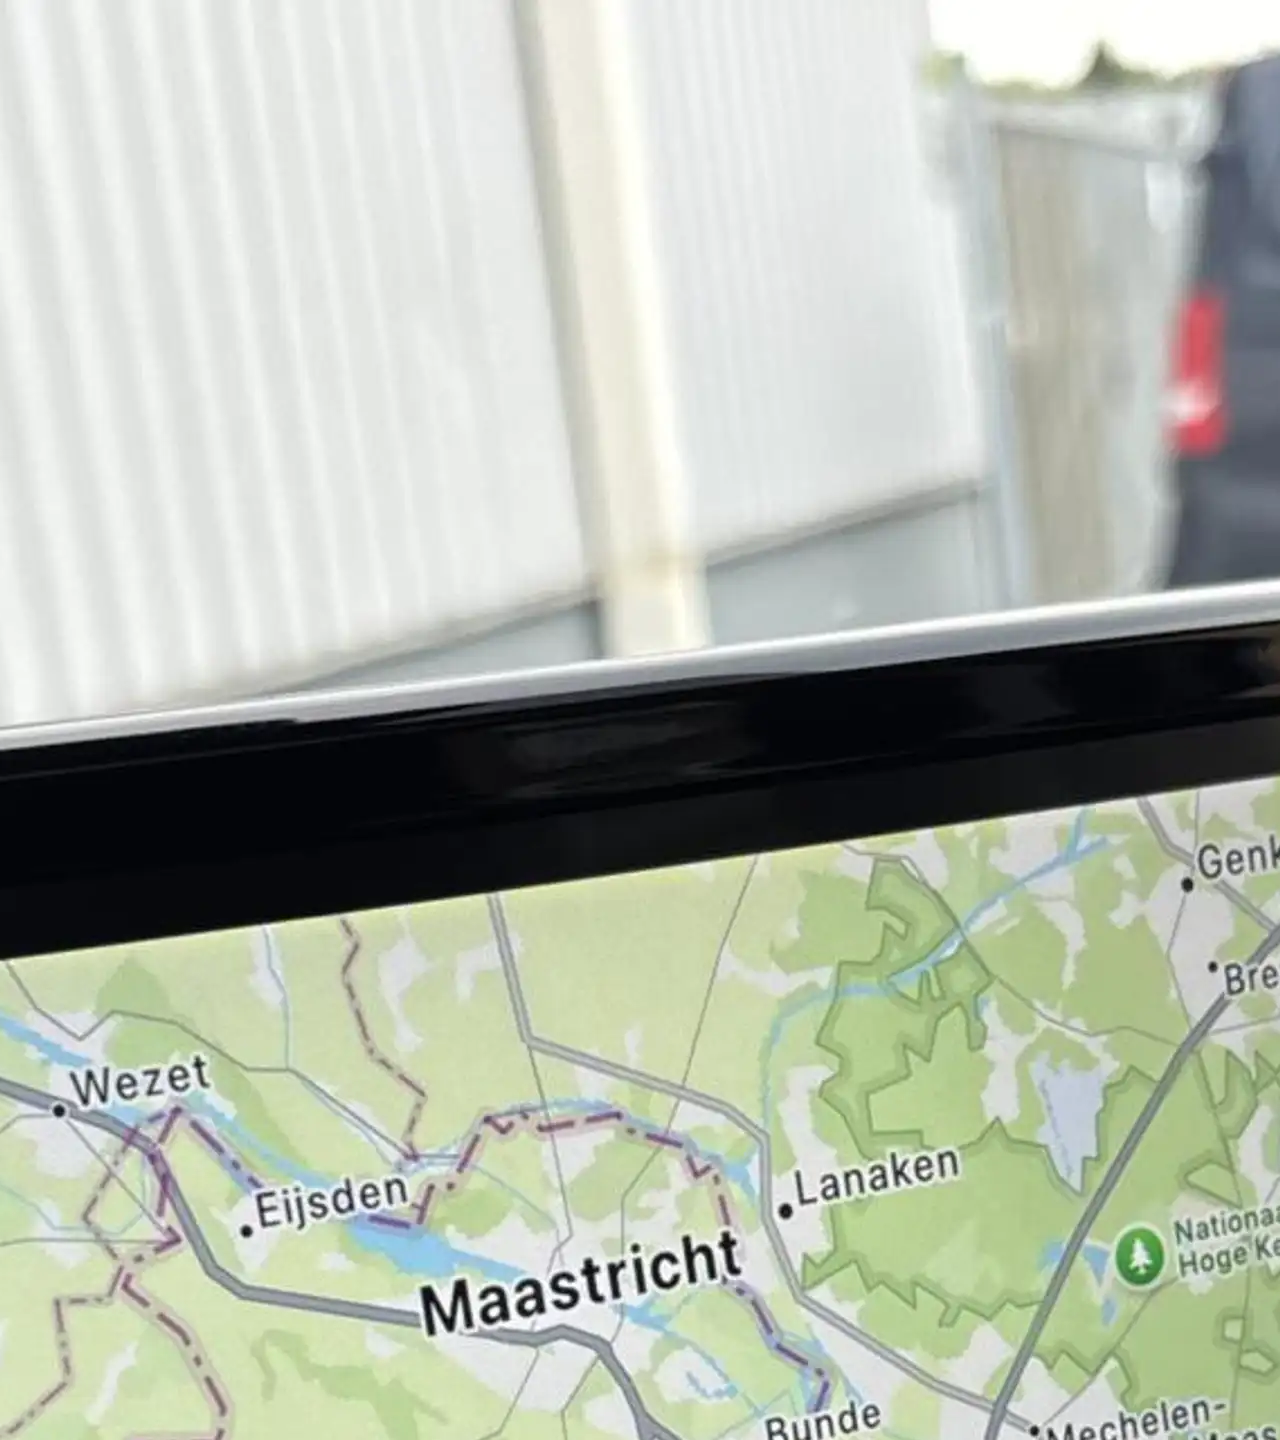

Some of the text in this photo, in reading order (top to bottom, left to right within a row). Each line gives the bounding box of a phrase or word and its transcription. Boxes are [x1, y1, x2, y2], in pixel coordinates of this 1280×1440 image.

[69, 1054, 210, 1104] Wezet
[255, 1175, 409, 1229] Eijsden
[794, 1146, 960, 1205] Lanaken
[419, 1229, 743, 1337] Maastricht
[1177, 1244, 1249, 1278] Hoge
